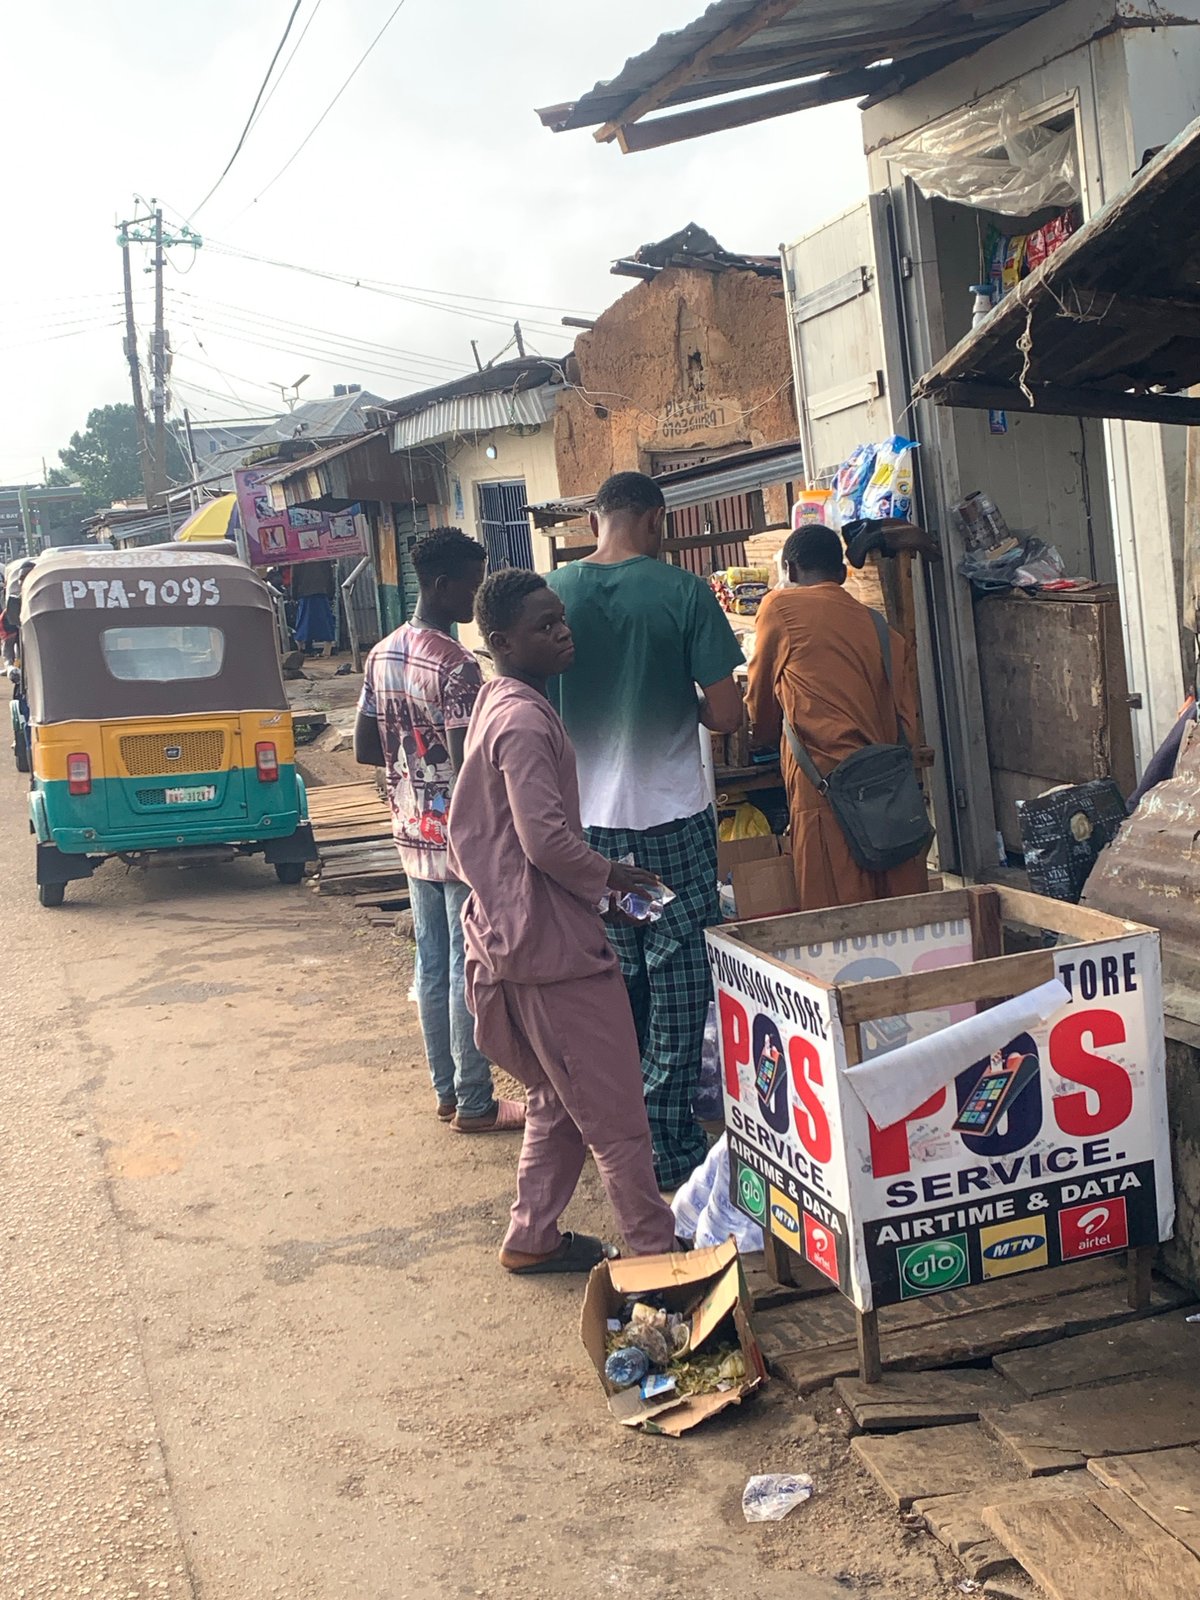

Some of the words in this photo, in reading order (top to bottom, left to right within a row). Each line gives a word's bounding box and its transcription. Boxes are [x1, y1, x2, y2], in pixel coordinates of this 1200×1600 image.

[707, 942, 779, 1014] PROVISION
[775, 981, 828, 1041] STORE
[1058, 952, 1138, 1003] TORE
[718, 988, 832, 1164] POS
[731, 1105, 832, 1198] SERVICE.
[886, 1138, 1127, 1208] SERVICE.
[730, 1135, 785, 1190] AIRTIME
[788, 1180, 799, 1201] &
[802, 1190, 842, 1235] DATA
[742, 1180, 760, 1203] glo
[876, 1198, 1016, 1246] AIRTIME
[1027, 1191, 1050, 1212] &
[1061, 1171, 1142, 1204] DATA
[774, 1206, 796, 1232] MTN
[992, 1236, 1036, 1259] MTN
[1078, 1233, 1112, 1251] airtel
[912, 1253, 955, 1282] glo
